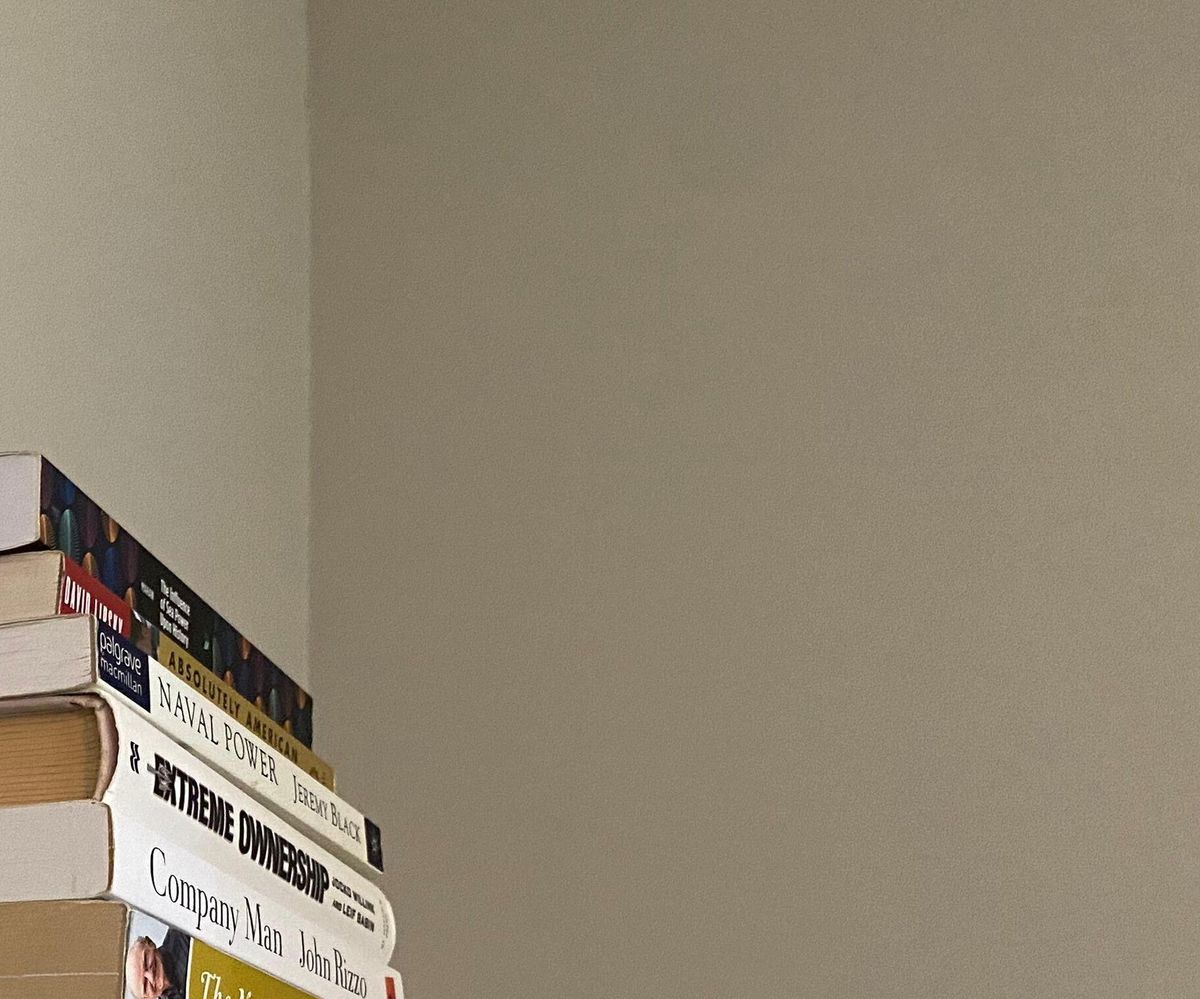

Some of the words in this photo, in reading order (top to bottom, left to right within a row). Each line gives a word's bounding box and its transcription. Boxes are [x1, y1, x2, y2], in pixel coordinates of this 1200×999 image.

[64, 575, 91, 615] DAVID
[100, 632, 142, 676] palgrave
[100, 657, 143, 697] macmillan
[158, 676, 219, 745] NAVAL
[224, 722, 279, 786] POWER
[168, 651, 240, 718] ABSOLUTELY
[246, 712, 298, 763] AMERICAN
[153, 752, 234, 843] EXTREME
[238, 809, 330, 904] OWNERSHIP
[293, 775, 328, 820] JEREMY
[330, 801, 361, 844] BLACK
[150, 846, 240, 946] Company
[244, 896, 283, 957] Man
[299, 928, 331, 981] John
[333, 947, 368, 999] Rizzo
